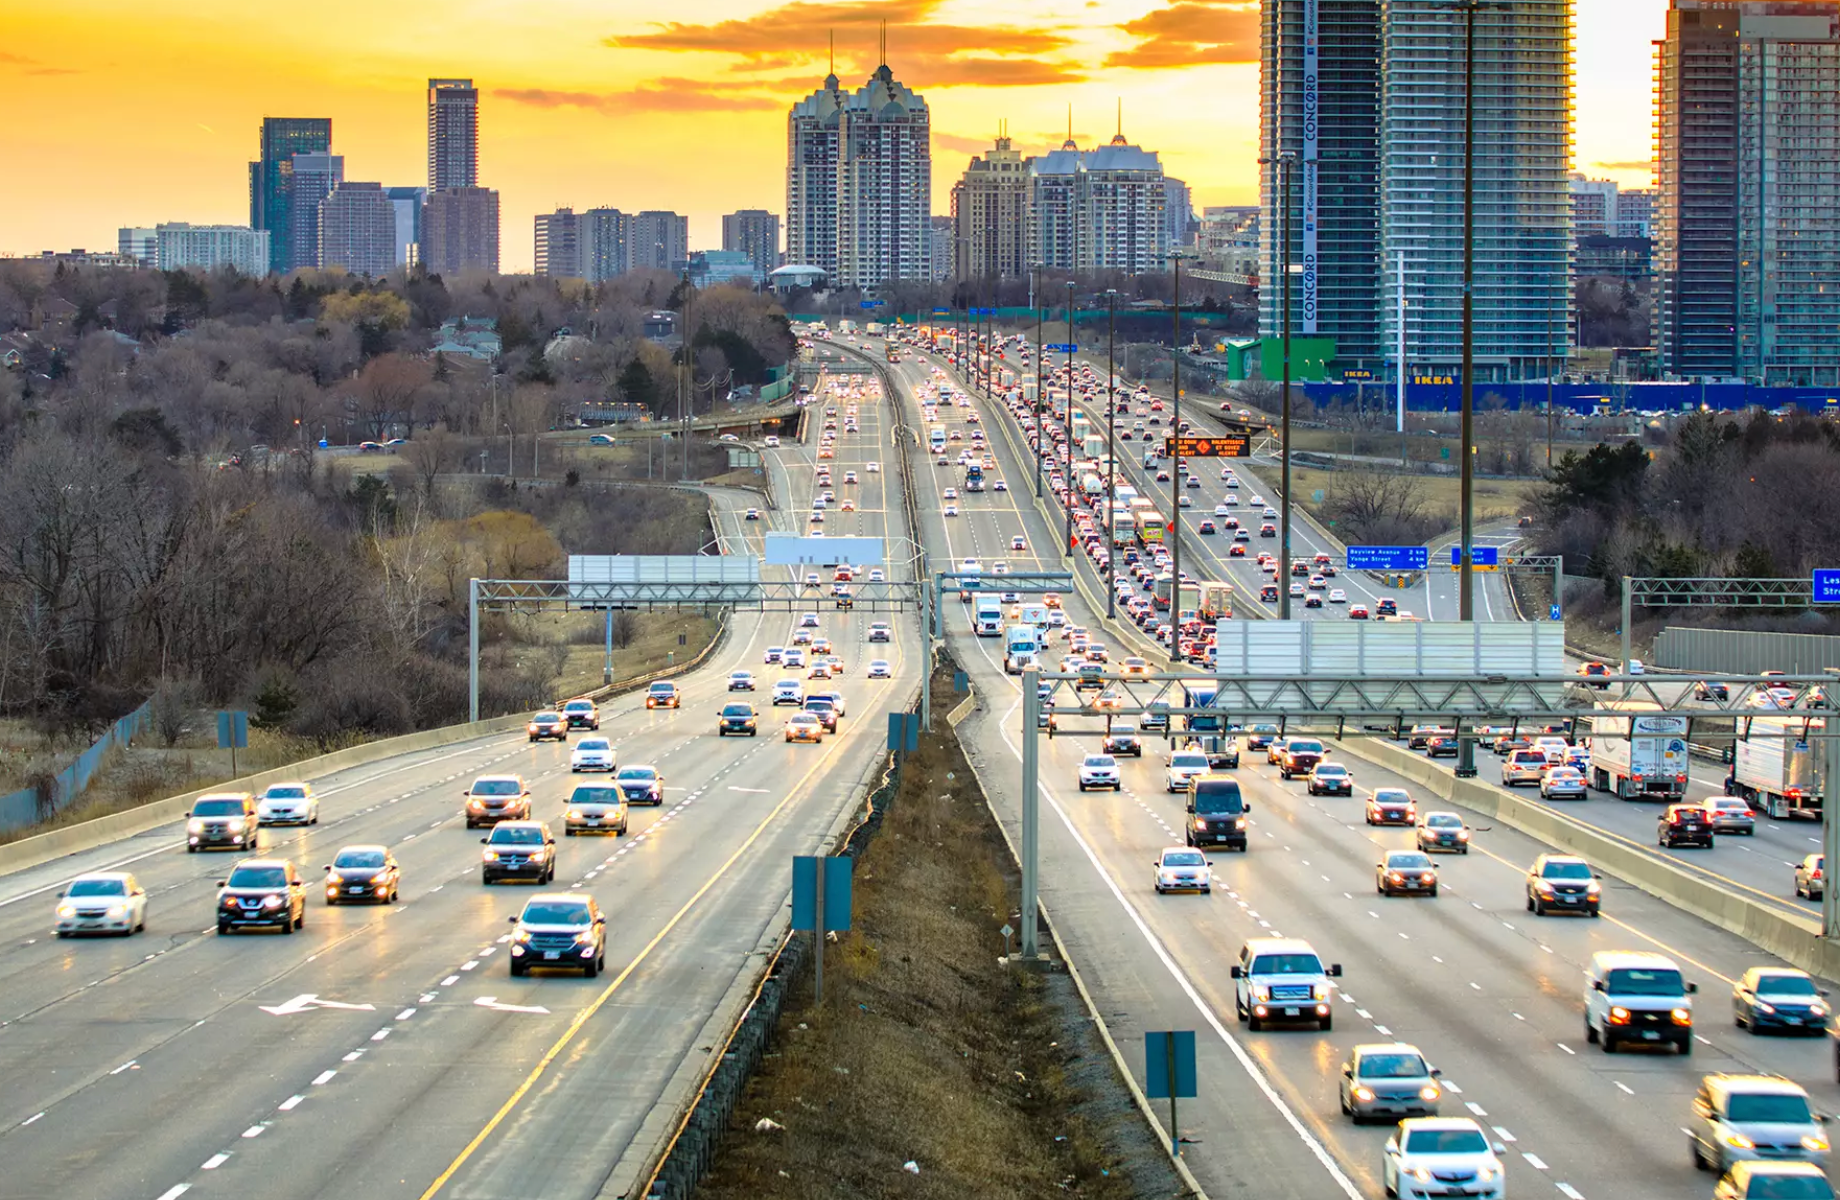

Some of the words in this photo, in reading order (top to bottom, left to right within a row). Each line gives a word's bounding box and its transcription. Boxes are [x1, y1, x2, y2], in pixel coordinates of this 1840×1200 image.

[1414, 376, 1454, 385] IKEA
[1823, 576, 1840, 584] Les
[1552, 606, 1560, 614] H
